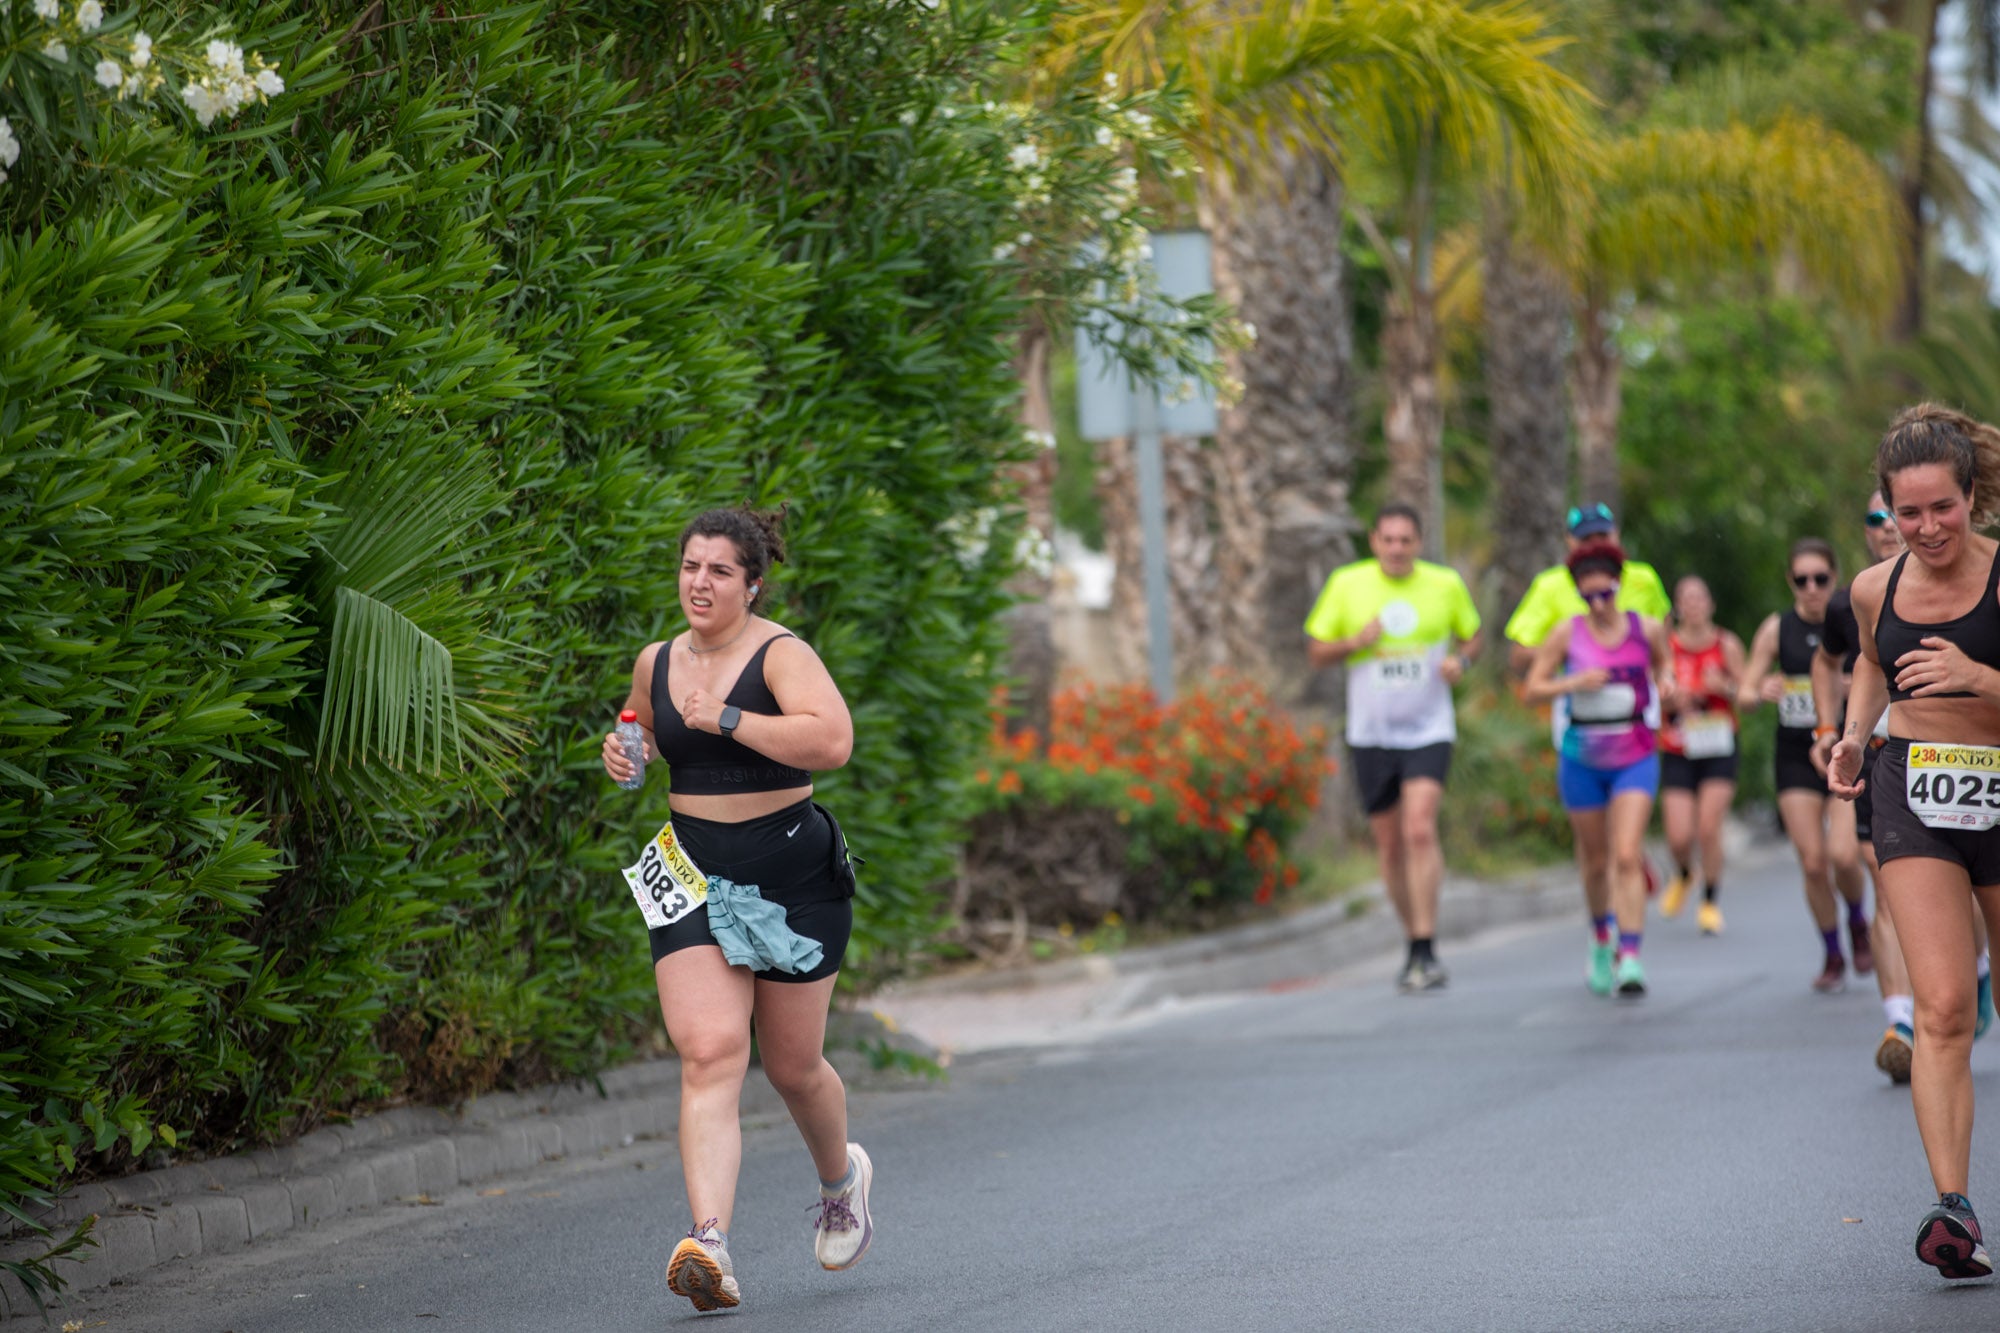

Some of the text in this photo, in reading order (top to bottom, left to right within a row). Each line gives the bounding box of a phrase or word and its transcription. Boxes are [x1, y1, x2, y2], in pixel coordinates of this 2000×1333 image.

[1922, 749, 1993, 766] 38 FONDO
[1911, 773, 2000, 809] 4025
[665, 846, 695, 885] FONDO
